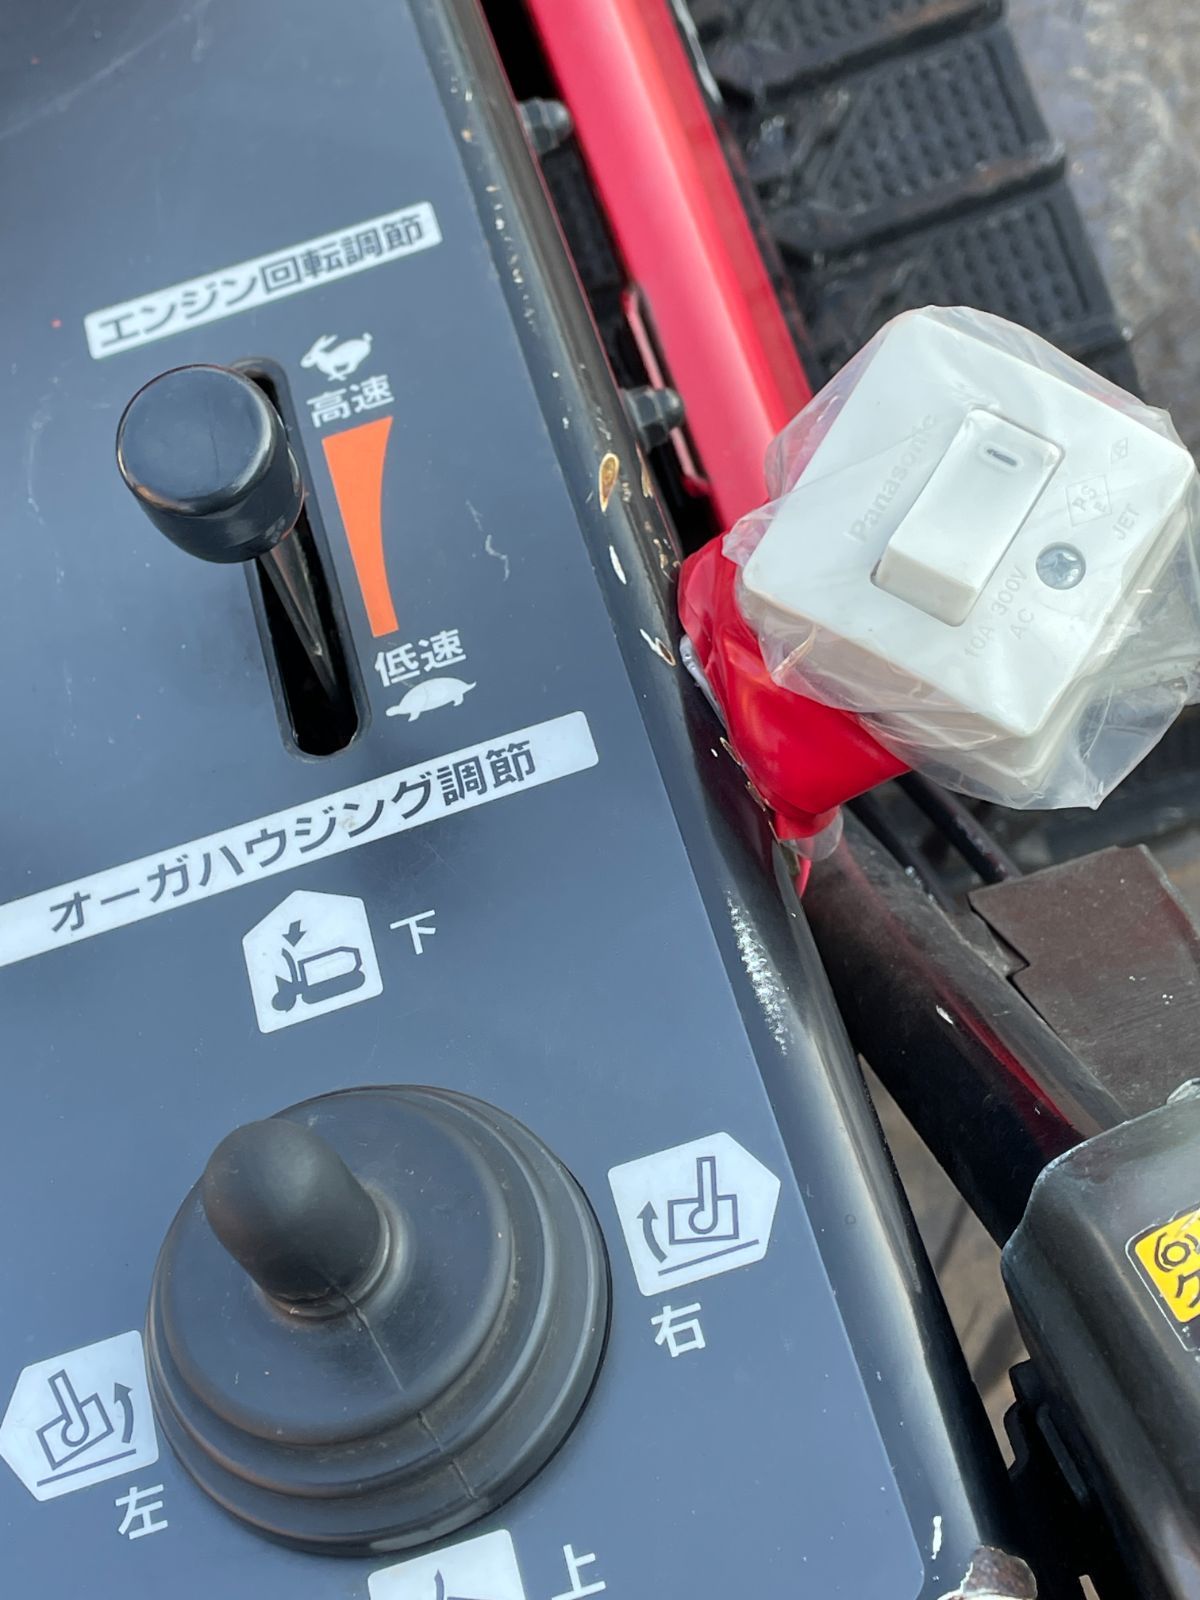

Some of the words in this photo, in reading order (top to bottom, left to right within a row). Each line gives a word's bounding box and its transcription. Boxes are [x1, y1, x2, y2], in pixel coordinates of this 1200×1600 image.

[98, 213, 425, 349] エンジン回転調節
[306, 375, 395, 427] 高速
[848, 413, 936, 542] Panasonic
[1112, 502, 1140, 540] JET
[964, 626, 995, 657] 10A
[991, 566, 1027, 616] 300V
[1010, 608, 1035, 640] AC
[374, 629, 468, 687] 低速
[50, 740, 537, 933] オーガハウジング調節
[390, 910, 437, 955] 下
[651, 1303, 706, 1357] 右
[115, 1484, 168, 1540] 左
[551, 1544, 606, 1600] 上
